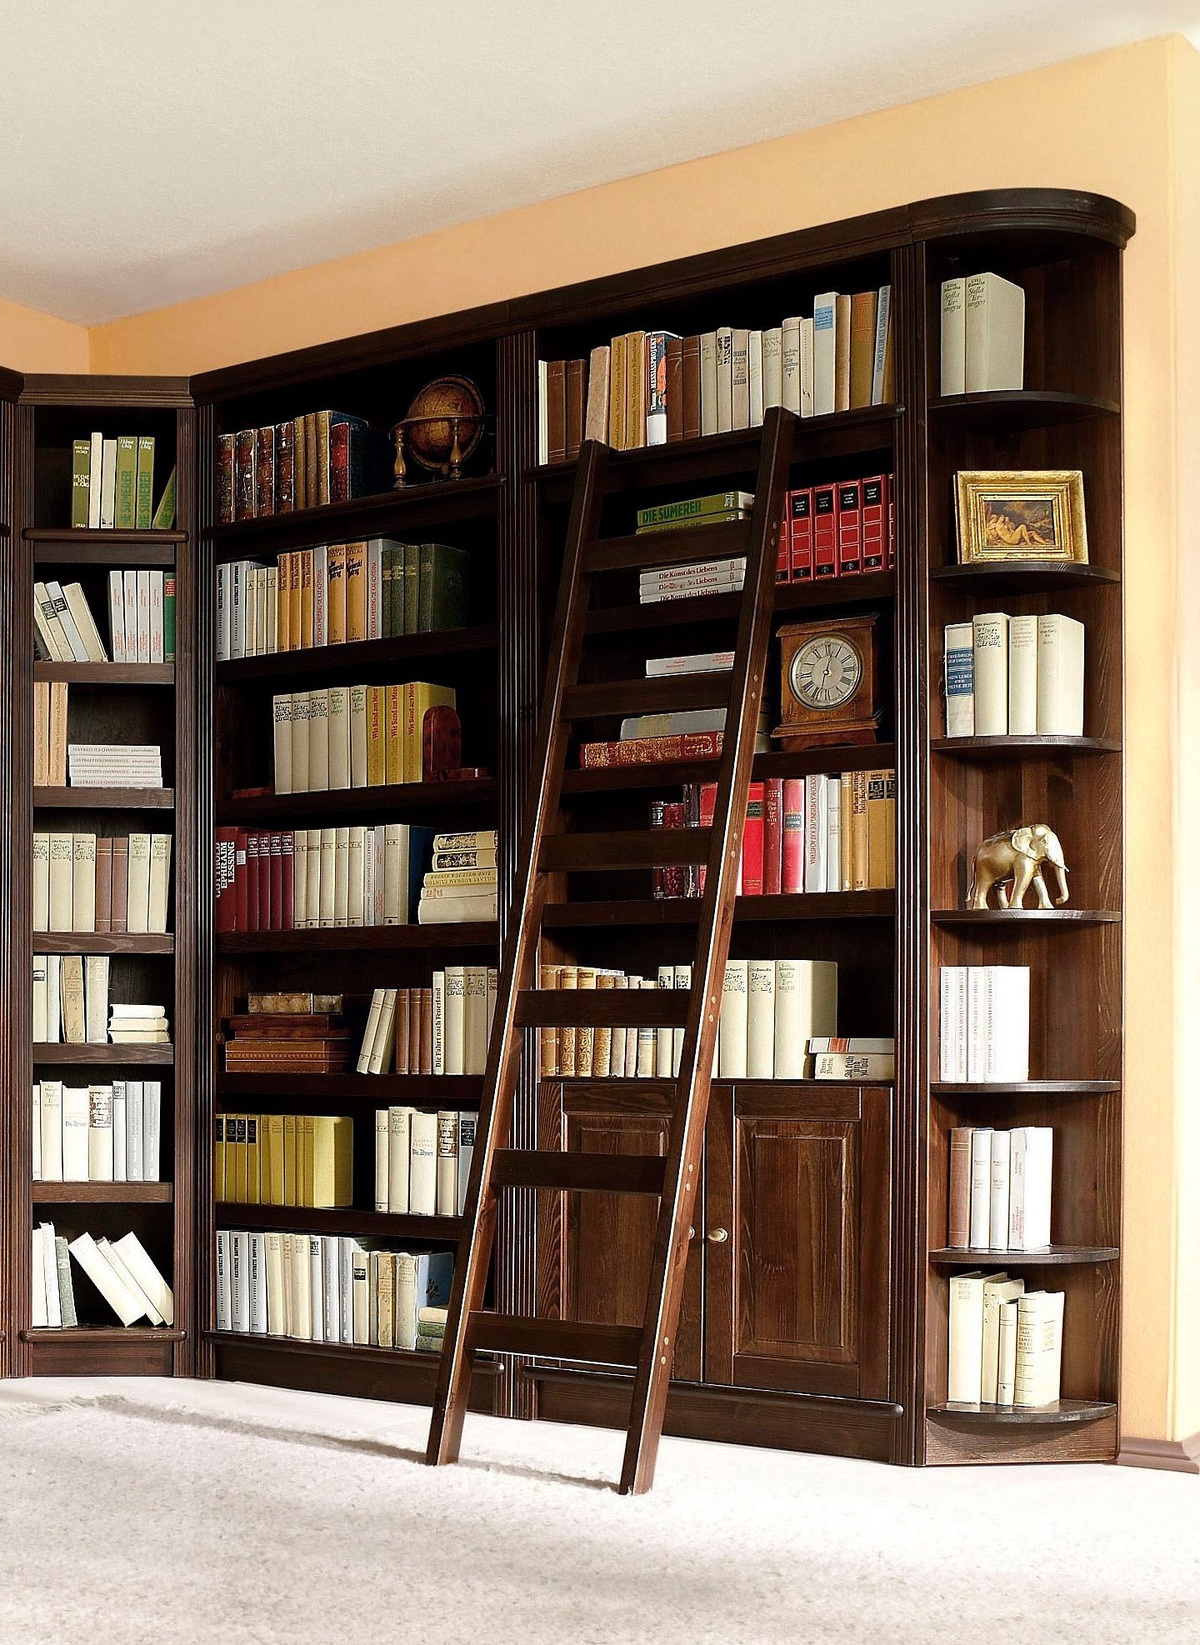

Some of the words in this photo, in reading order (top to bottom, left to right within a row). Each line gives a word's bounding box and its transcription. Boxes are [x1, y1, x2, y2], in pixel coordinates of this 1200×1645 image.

[120, 471, 132, 513] SUMERER
[139, 471, 150, 513] SUMERER
[643, 510, 657, 524] DIE
[658, 500, 702, 520] SUMERER
[139, 513, 149, 528] DIE
[669, 570, 685, 578] Kunst
[696, 566, 718, 574] Liebens
[390, 686, 398, 700] Meer
[372, 702, 379, 712] am
[390, 700, 398, 710] am
[408, 698, 415, 708] am
[390, 709, 398, 725] Sand
[390, 725, 398, 738] Wie
[858, 772, 866, 799] Kochbuch
